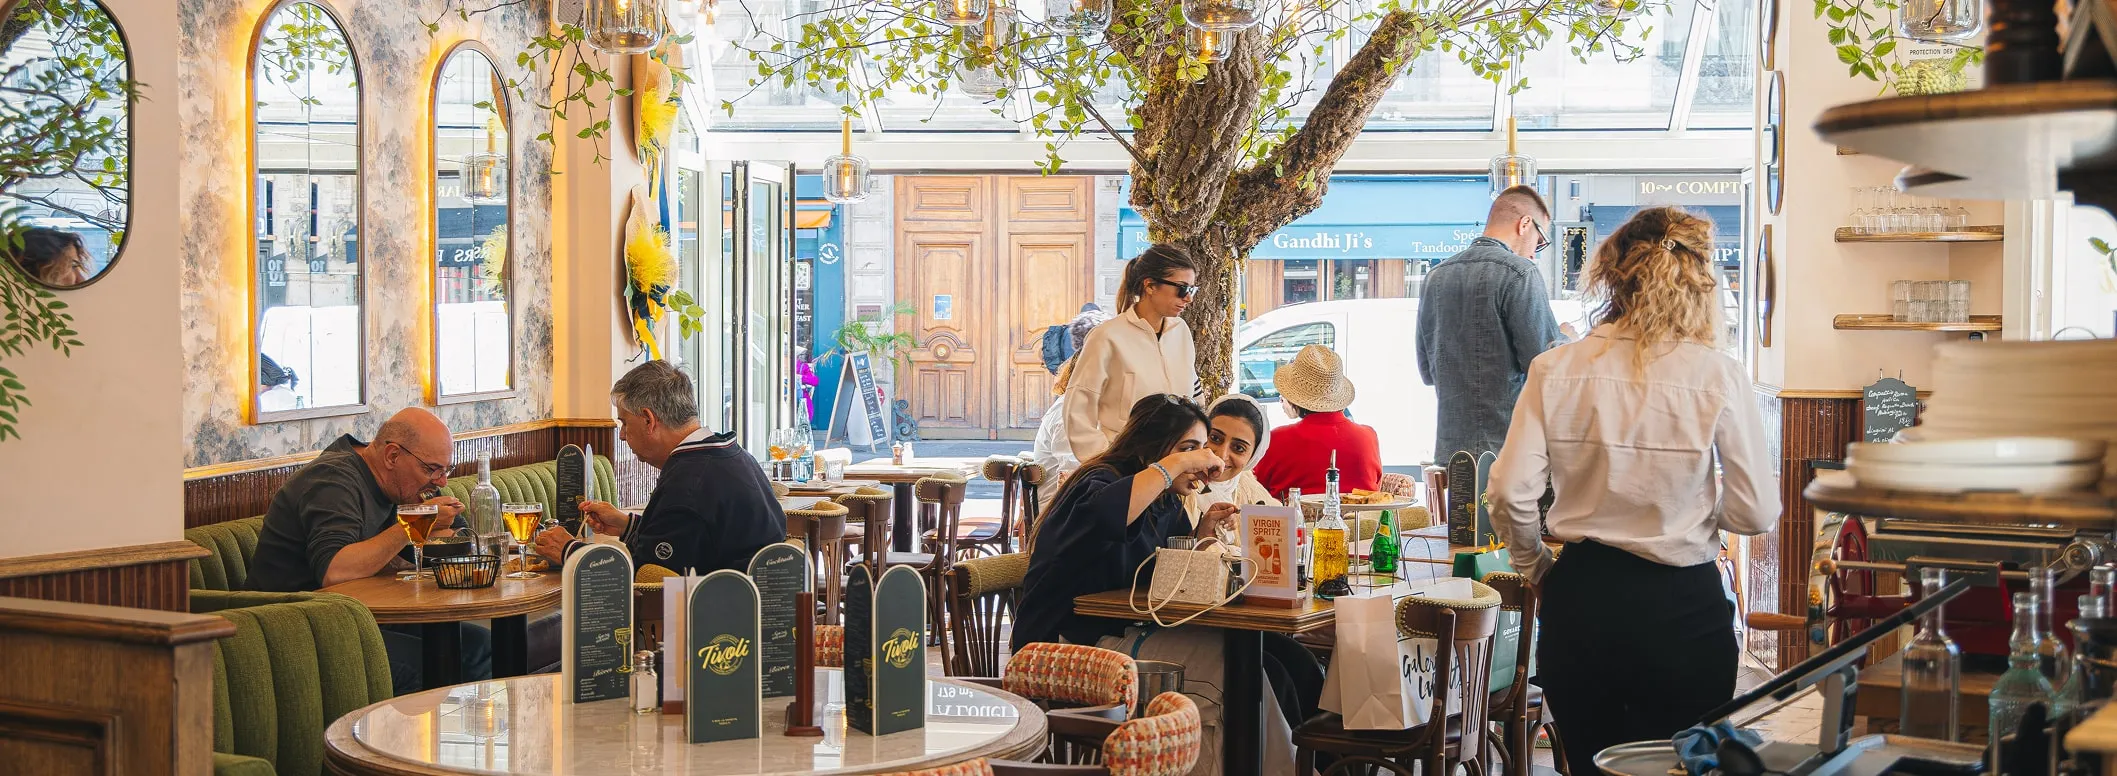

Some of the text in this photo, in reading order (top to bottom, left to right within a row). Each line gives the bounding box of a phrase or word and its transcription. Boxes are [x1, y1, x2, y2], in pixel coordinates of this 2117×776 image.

[1909, 48, 1941, 56] PROTECTION
[1640, 181, 1655, 194] 10
[1273, 232, 1373, 252] Gandhi Ji's
[1411, 240, 1471, 253] Tandoori
[1253, 519, 1281, 528] VIRGIN
[1253, 527, 1281, 536] SPRITZ
[881, 630, 920, 663] Tivoli
[697, 637, 751, 670] Tivoli
